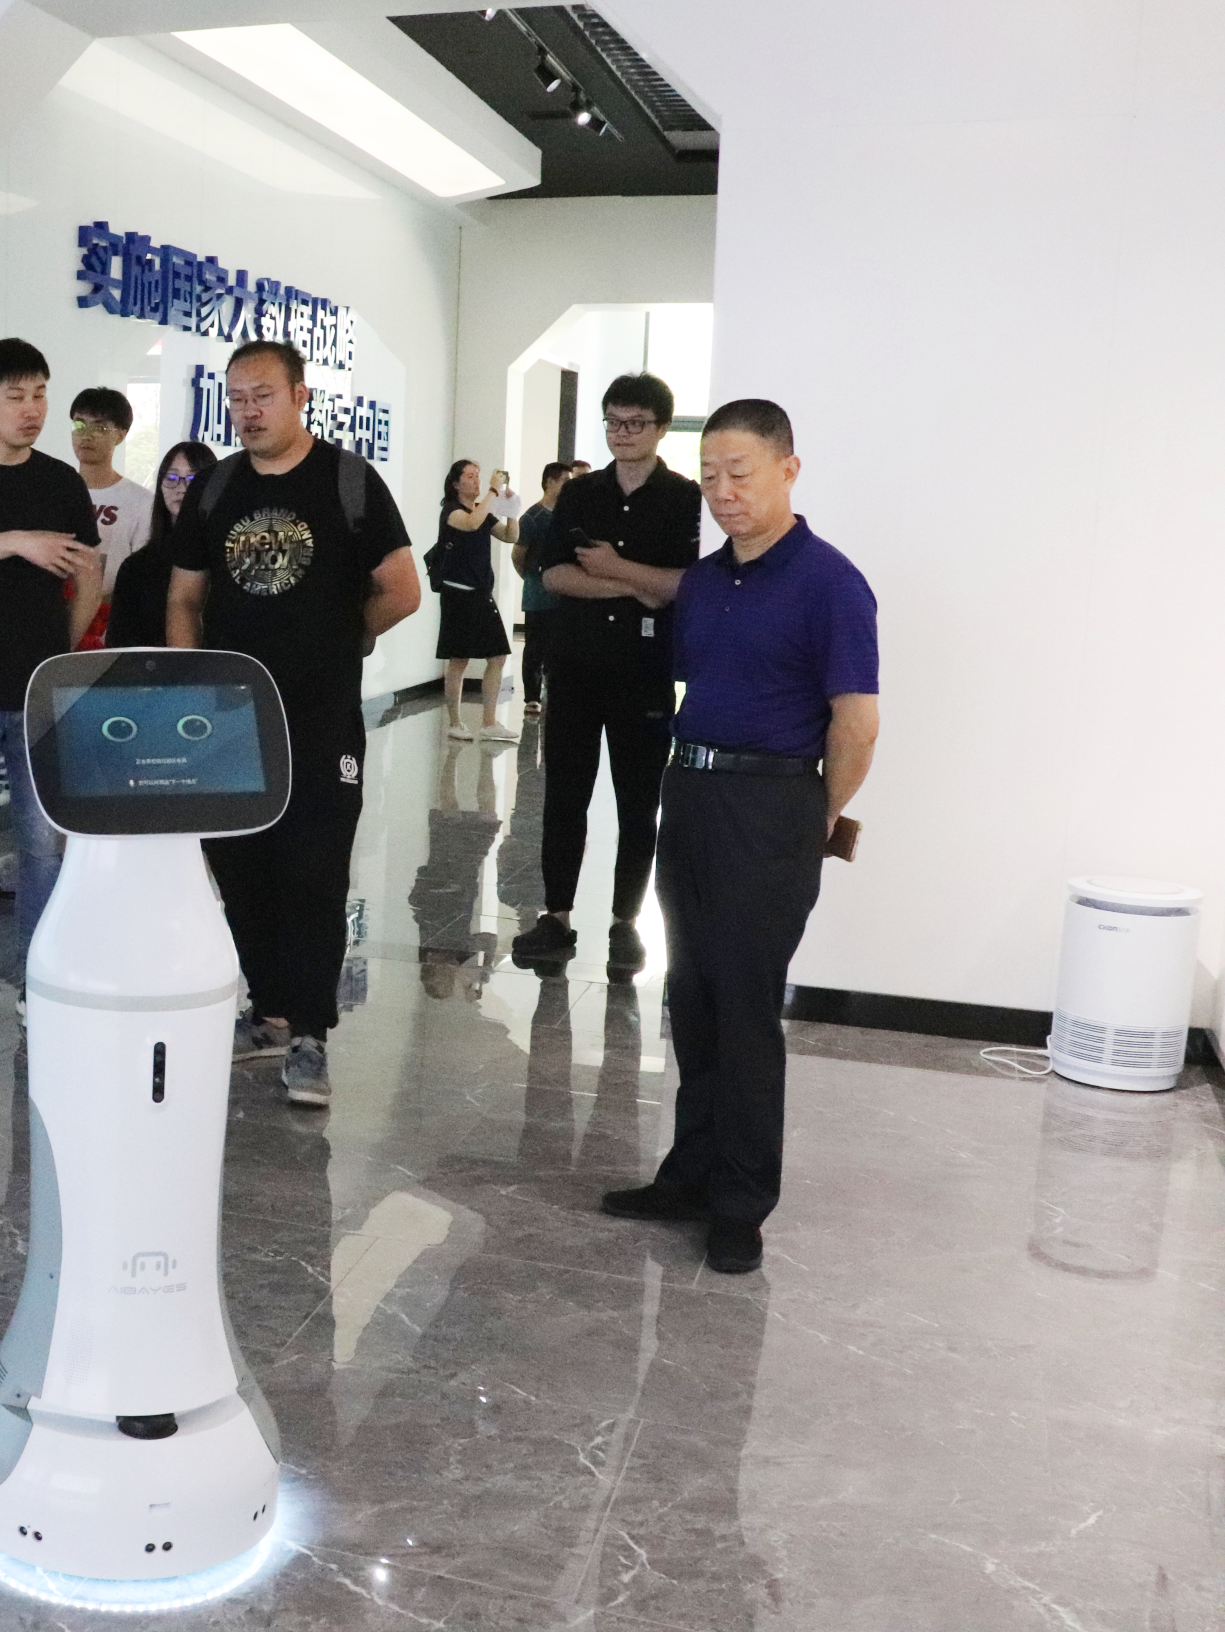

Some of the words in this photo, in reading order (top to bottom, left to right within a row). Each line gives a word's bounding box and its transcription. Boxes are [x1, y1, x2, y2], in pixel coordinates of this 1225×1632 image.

[77, 221, 357, 371] 实施国家大数据战略
[107, 1283, 187, 1294] AIBAYES
